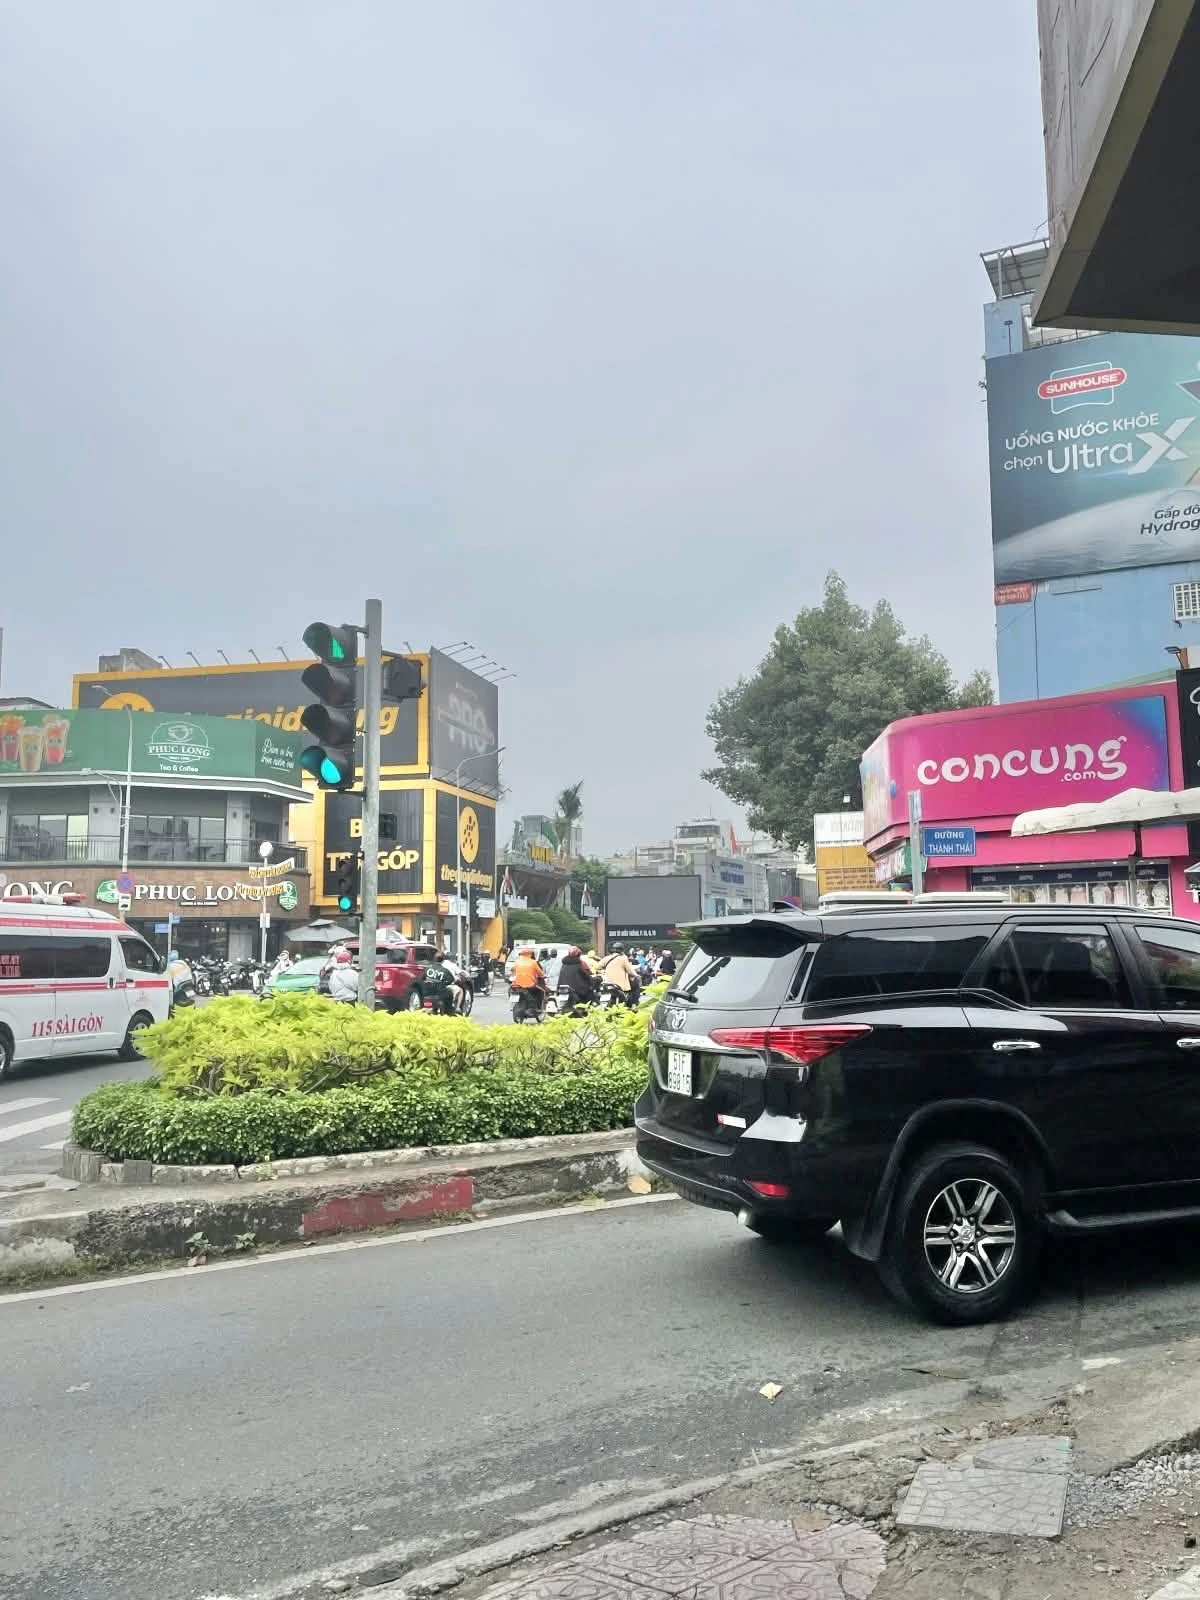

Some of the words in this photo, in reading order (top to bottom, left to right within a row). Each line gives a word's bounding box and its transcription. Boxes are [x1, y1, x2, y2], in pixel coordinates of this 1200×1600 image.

[1045, 373, 1119, 395] SUNHOUSE
[1005, 429, 1054, 450] UỐNG
[1057, 420, 1109, 441] NƯỚC
[1112, 411, 1160, 432] KHỎE
[1003, 454, 1043, 471] chọn
[1154, 505, 1181, 520] Gấp
[917, 735, 1128, 786] concung
[134, 885, 197, 900] PHUC
[32, 1022, 53, 1037] 115
[55, 1015, 76, 1035] SÀI
[78, 1012, 104, 1034] GÒN
